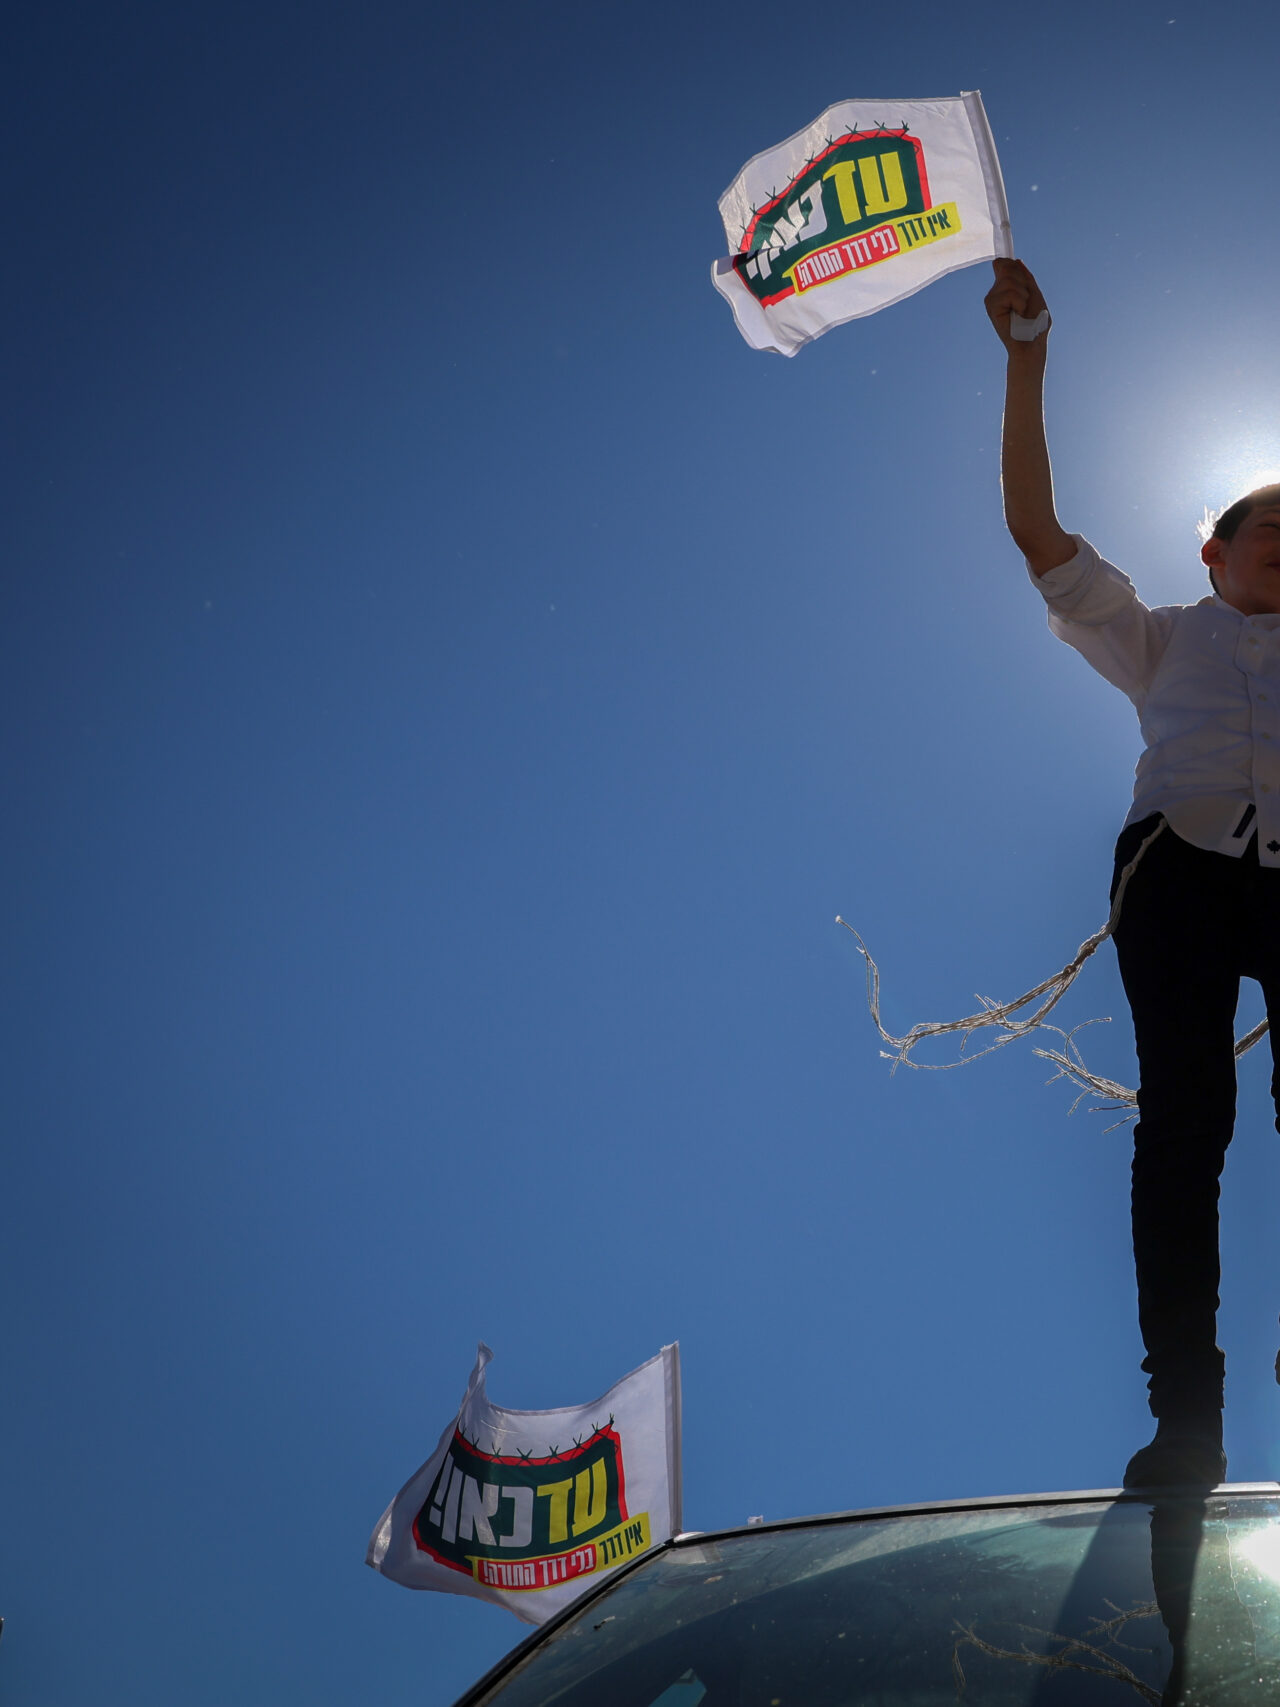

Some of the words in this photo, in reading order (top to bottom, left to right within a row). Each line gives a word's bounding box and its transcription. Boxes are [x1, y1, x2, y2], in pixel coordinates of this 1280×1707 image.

[822, 151, 908, 225] עד
[898, 217, 927, 247] דרך
[926, 208, 951, 237] אין
[842, 237, 873, 269] דרך
[871, 228, 898, 255] בלי
[429, 1454, 534, 1548] כאן!
[536, 1457, 607, 1544] עד
[599, 1533, 624, 1565] דרך
[624, 1521, 644, 1554] אין
[539, 1556, 567, 1586] דרך
[571, 1547, 594, 1573] בלי
